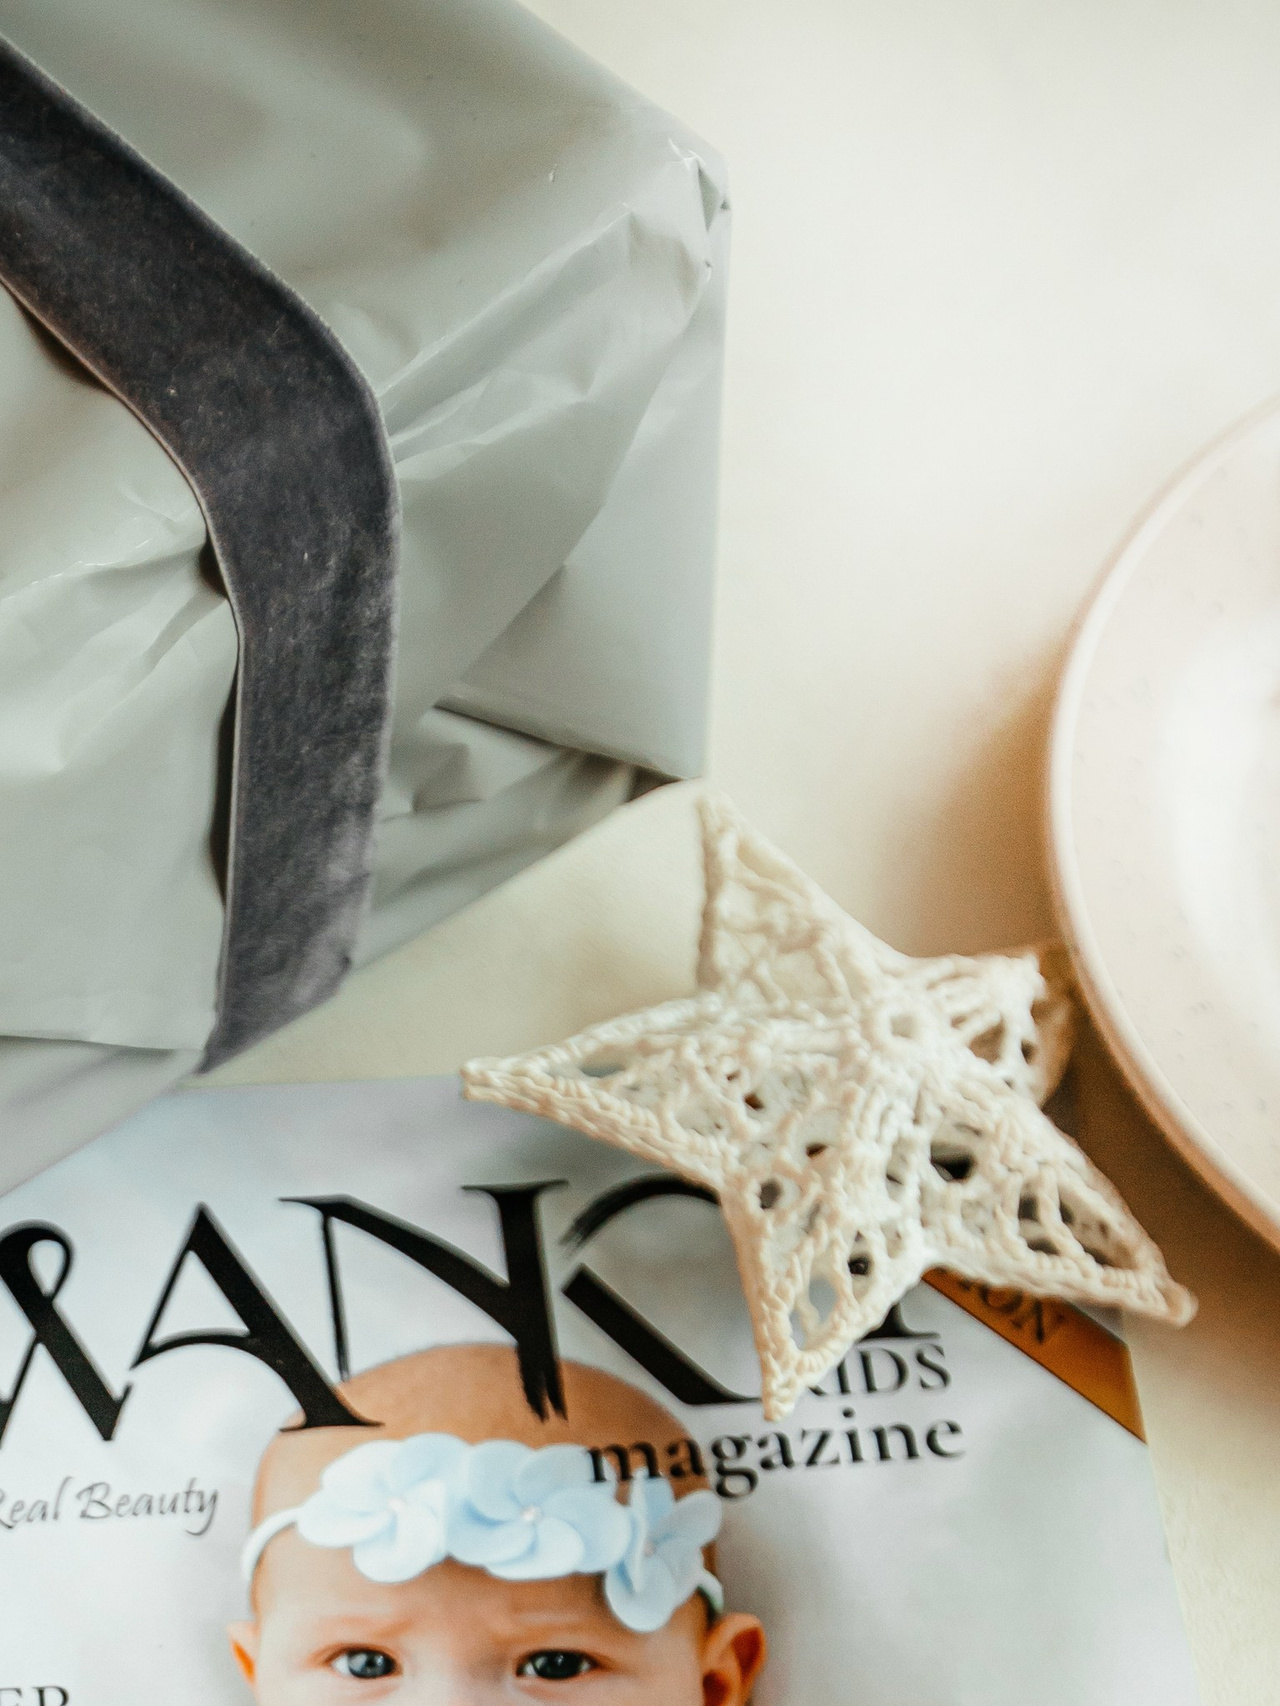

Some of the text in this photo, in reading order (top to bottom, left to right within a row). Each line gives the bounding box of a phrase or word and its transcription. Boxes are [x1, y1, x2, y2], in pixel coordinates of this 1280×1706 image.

[808, 1342, 952, 1396] IDS
[586, 1407, 966, 1498] magazine
[75, 1478, 218, 1536] Beauty
